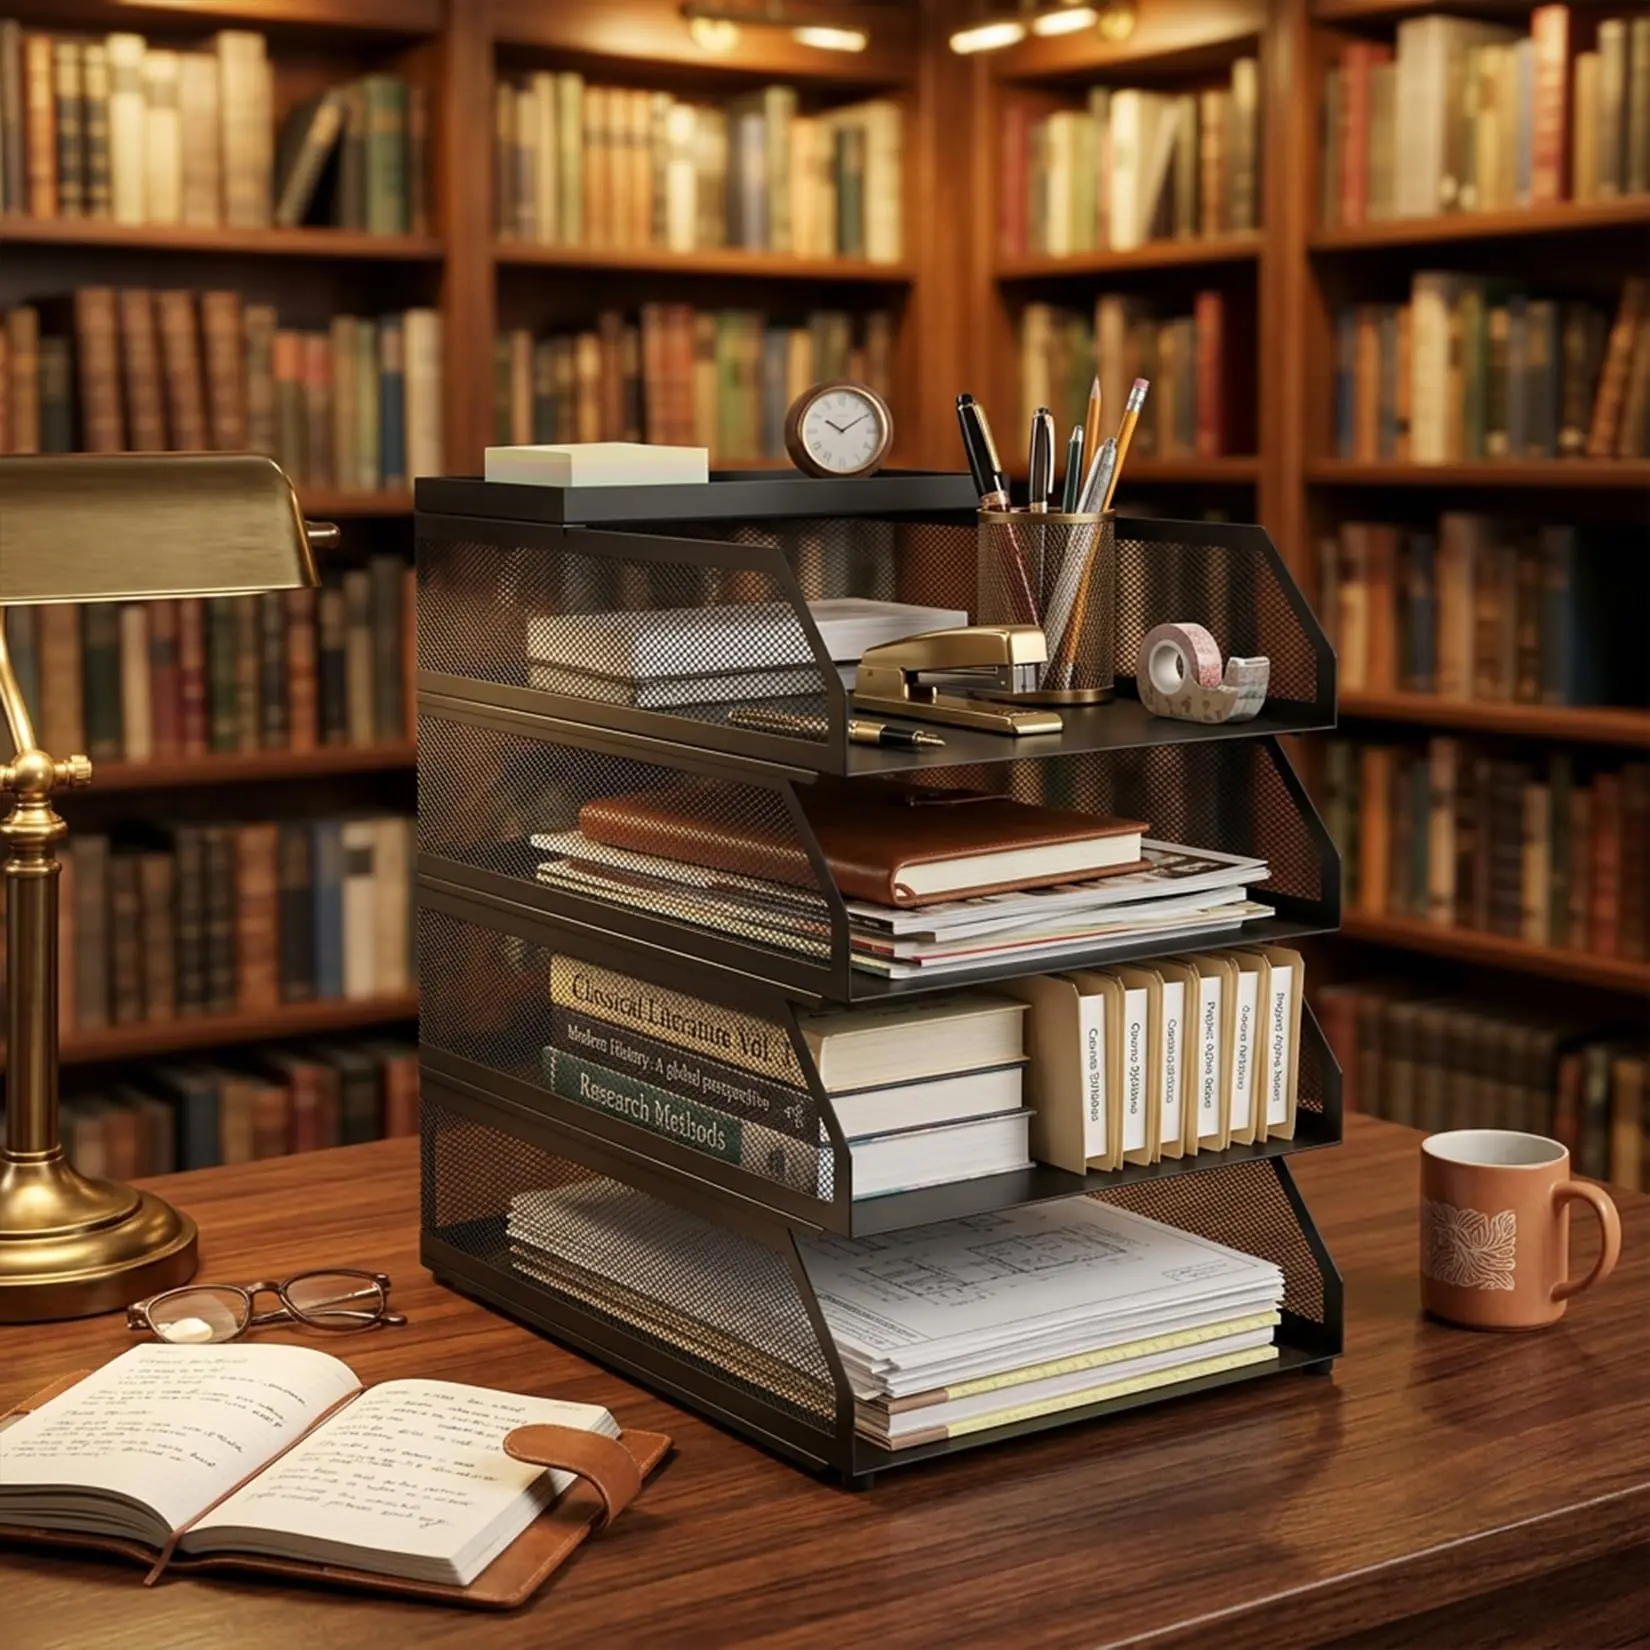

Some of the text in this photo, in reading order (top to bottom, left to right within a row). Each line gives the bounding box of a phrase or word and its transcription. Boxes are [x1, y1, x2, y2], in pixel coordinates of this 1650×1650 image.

[572, 974, 641, 1021] Classical
[649, 1000, 731, 1049] Literature
[567, 1024, 606, 1050] Modern
[666, 1061, 700, 1091] global
[580, 1072, 650, 1123] Research
[654, 1100, 726, 1151] Methods
